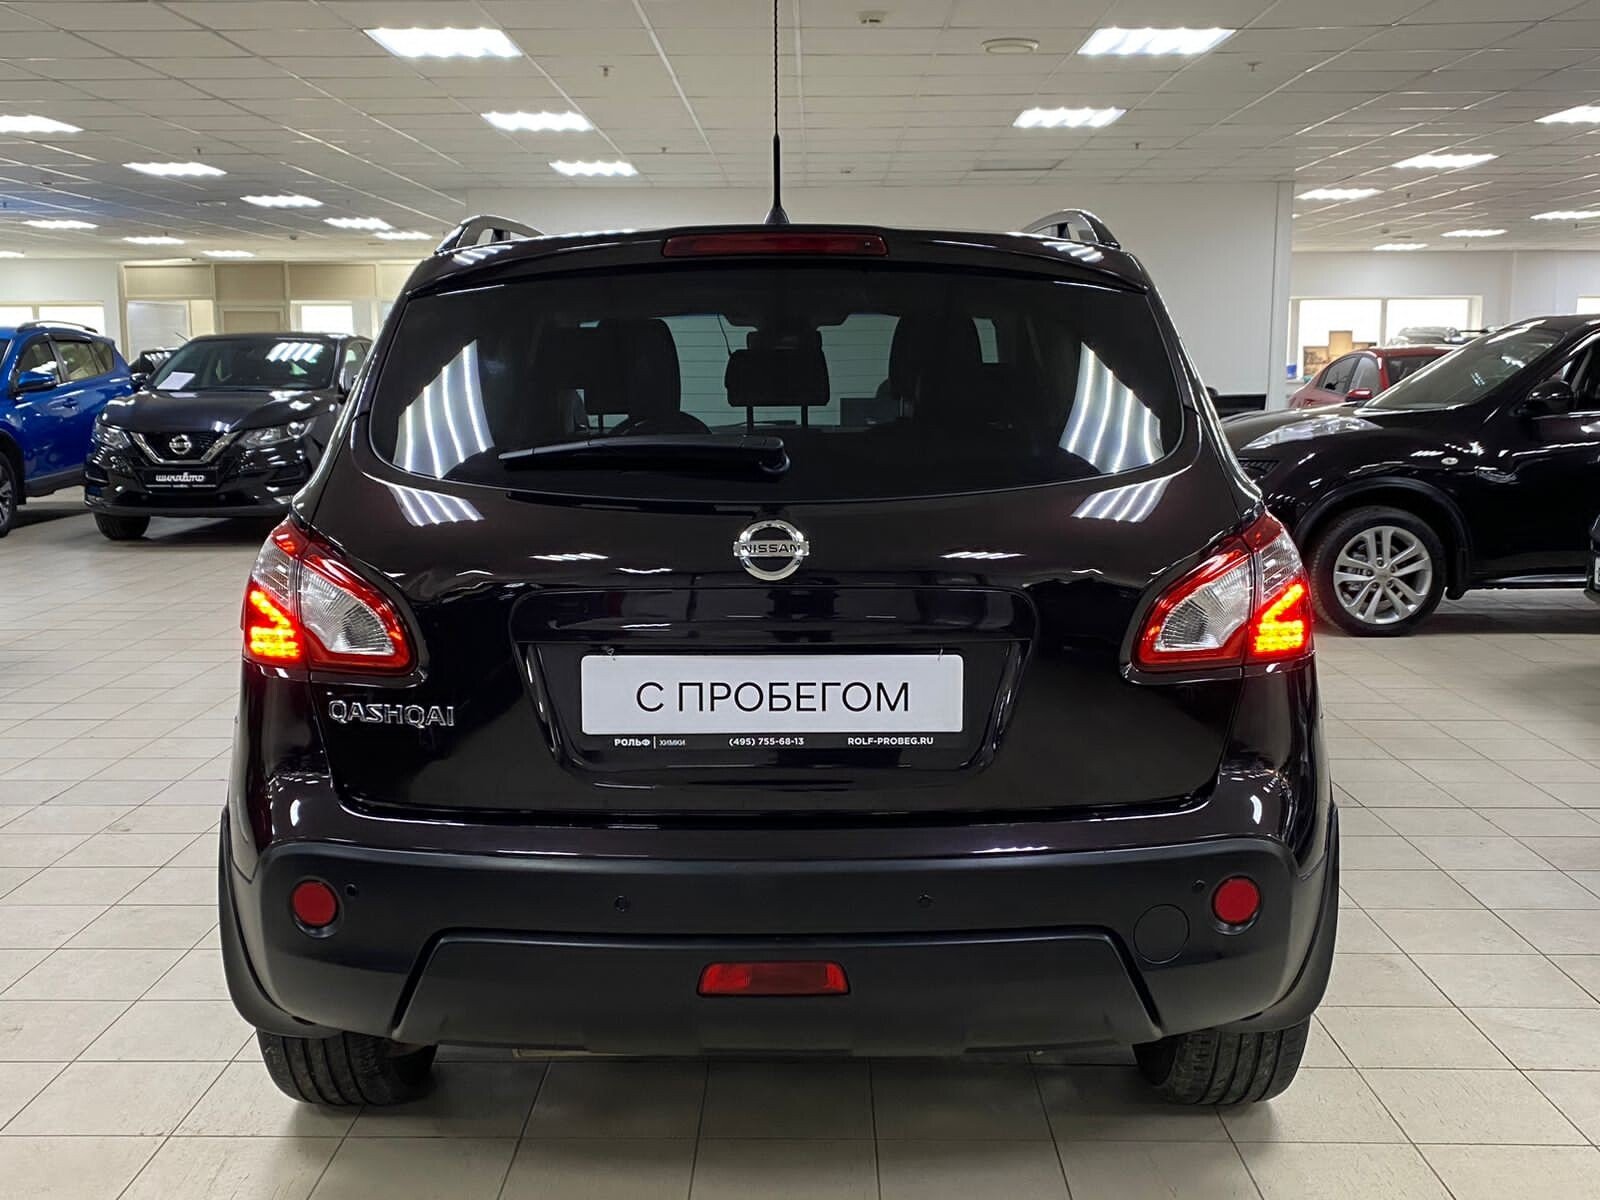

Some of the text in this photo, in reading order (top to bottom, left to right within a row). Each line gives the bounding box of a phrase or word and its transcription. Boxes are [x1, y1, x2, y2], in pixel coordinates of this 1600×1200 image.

[741, 543, 801, 554] NISSAN
[636, 681, 910, 713] С ПРОБЕГОМ
[328, 699, 456, 729] QASHQAI
[614, 737, 651, 747] РОЛЬФ
[728, 736, 805, 747] (495) 755-68-13
[847, 736, 934, 746] ROLF-PROBEG.RU
